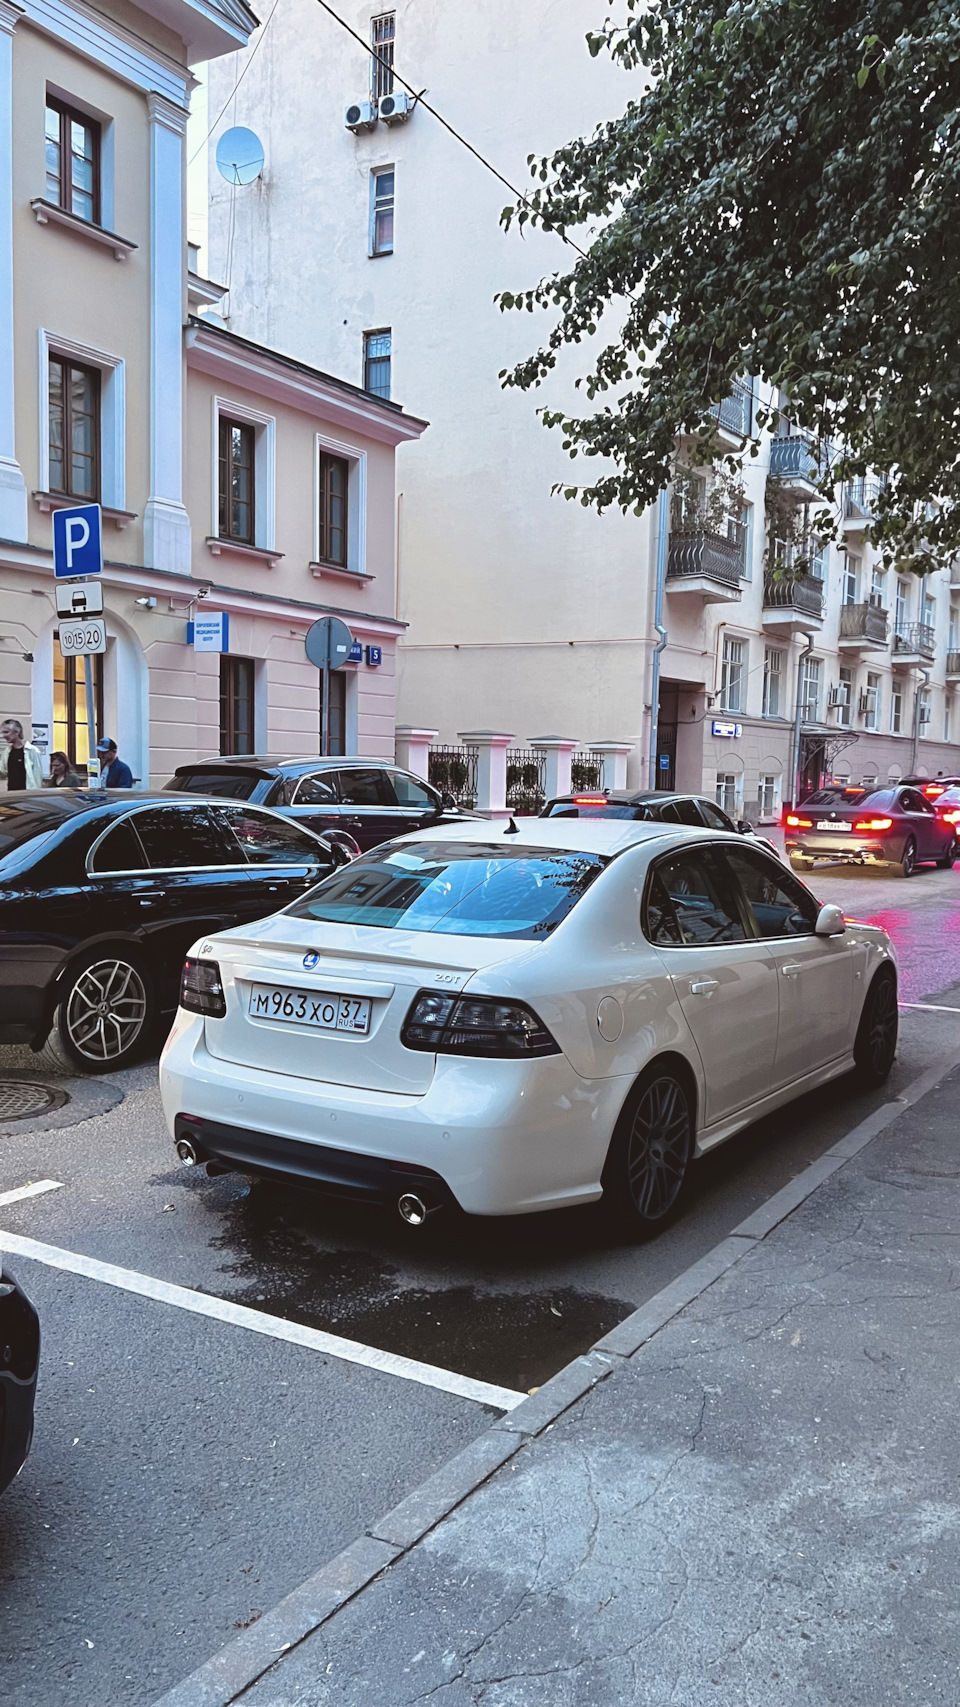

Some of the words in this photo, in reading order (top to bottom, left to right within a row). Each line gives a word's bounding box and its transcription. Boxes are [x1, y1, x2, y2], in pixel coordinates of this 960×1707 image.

[65, 516, 90, 568] P
[65, 635, 72, 644] 10
[74, 632, 83, 645] 15
[86, 630, 99, 644] 20
[373, 649, 379, 660] 5
[340, 999, 362, 1020] 37
[338, 1019, 354, 1027] RUS
